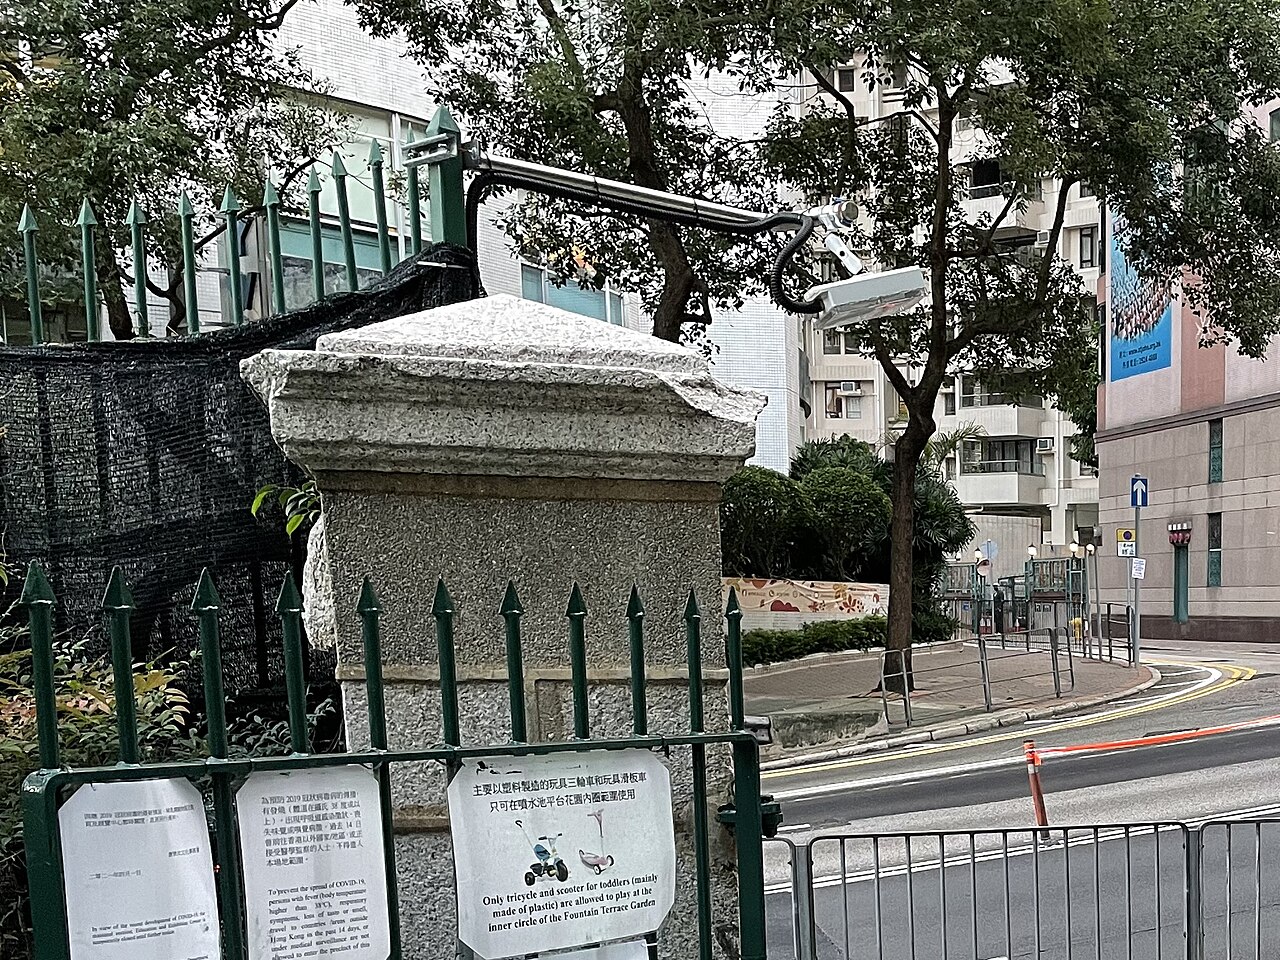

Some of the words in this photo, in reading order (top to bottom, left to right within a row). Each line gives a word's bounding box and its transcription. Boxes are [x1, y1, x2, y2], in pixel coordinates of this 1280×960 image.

[483, 894, 503, 908] Only
[507, 889, 537, 905] tricycle
[540, 887, 554, 897] and
[557, 882, 584, 895] scooter
[587, 880, 597, 891] for
[600, 876, 630, 889] toddlers
[632, 872, 658, 887] (mainly
[493, 906, 515, 918] made
[519, 904, 527, 914] of
[529, 899, 558, 915] plastic)
[575, 892, 604, 905] allowed
[606, 891, 613, 901] to
[616, 888, 630, 902] play
[633, 887, 639, 896] at
[642, 885, 652, 895] the
[489, 920, 512, 932] inner
[515, 916, 537, 928] circle
[539, 914, 547, 924] of
[550, 912, 561, 922] the
[564, 906, 598, 920] Fountain
[600, 901, 628, 914] Terrace
[631, 896, 656, 909] Garden
